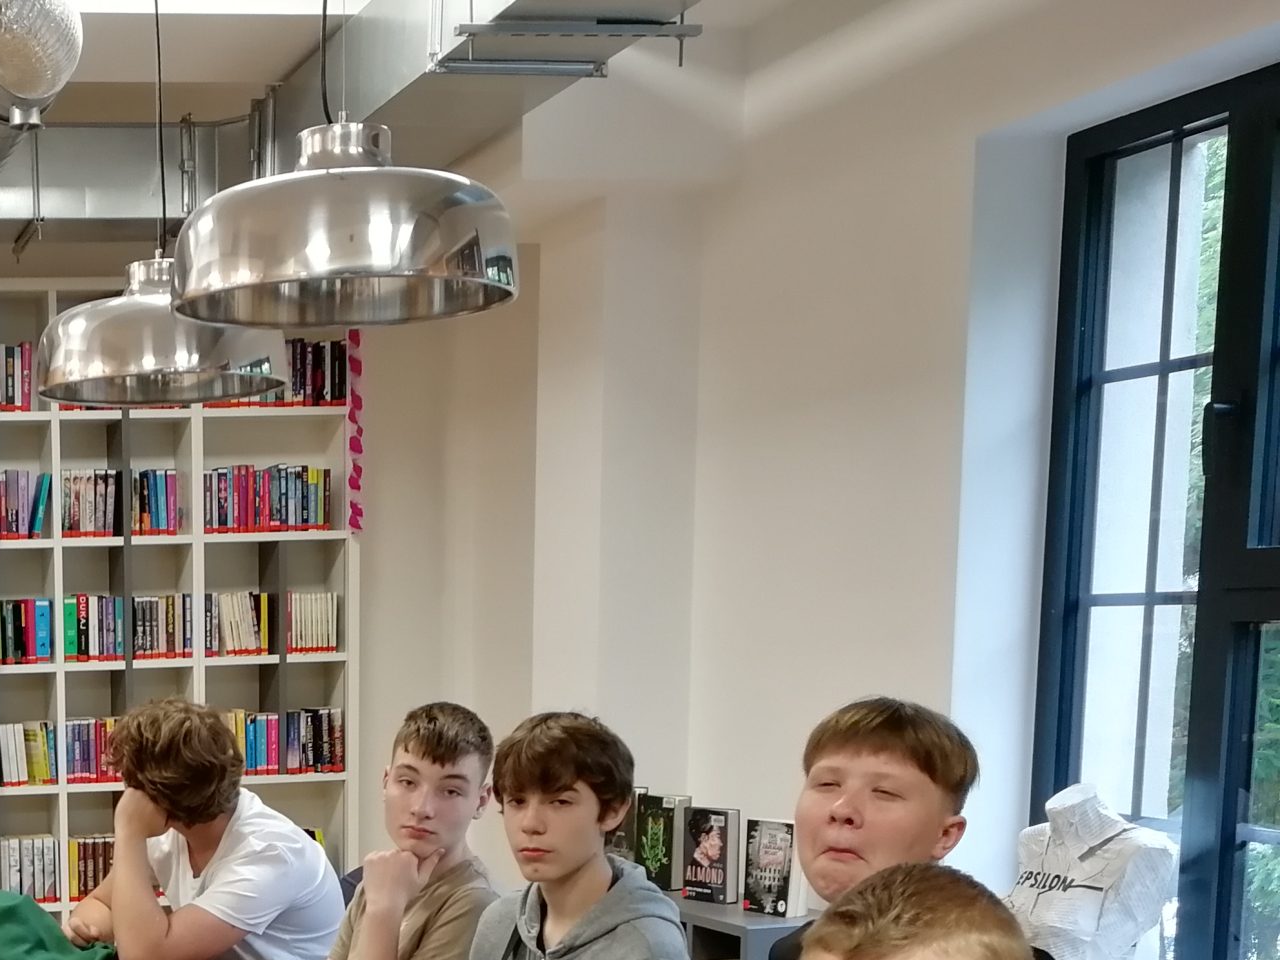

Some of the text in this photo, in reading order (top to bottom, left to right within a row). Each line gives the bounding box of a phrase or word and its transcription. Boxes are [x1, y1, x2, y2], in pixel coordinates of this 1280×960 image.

[79, 596, 87, 630] DUKAJ
[685, 865, 724, 884] ALMOND
[1016, 870, 1075, 893] EPSILON
